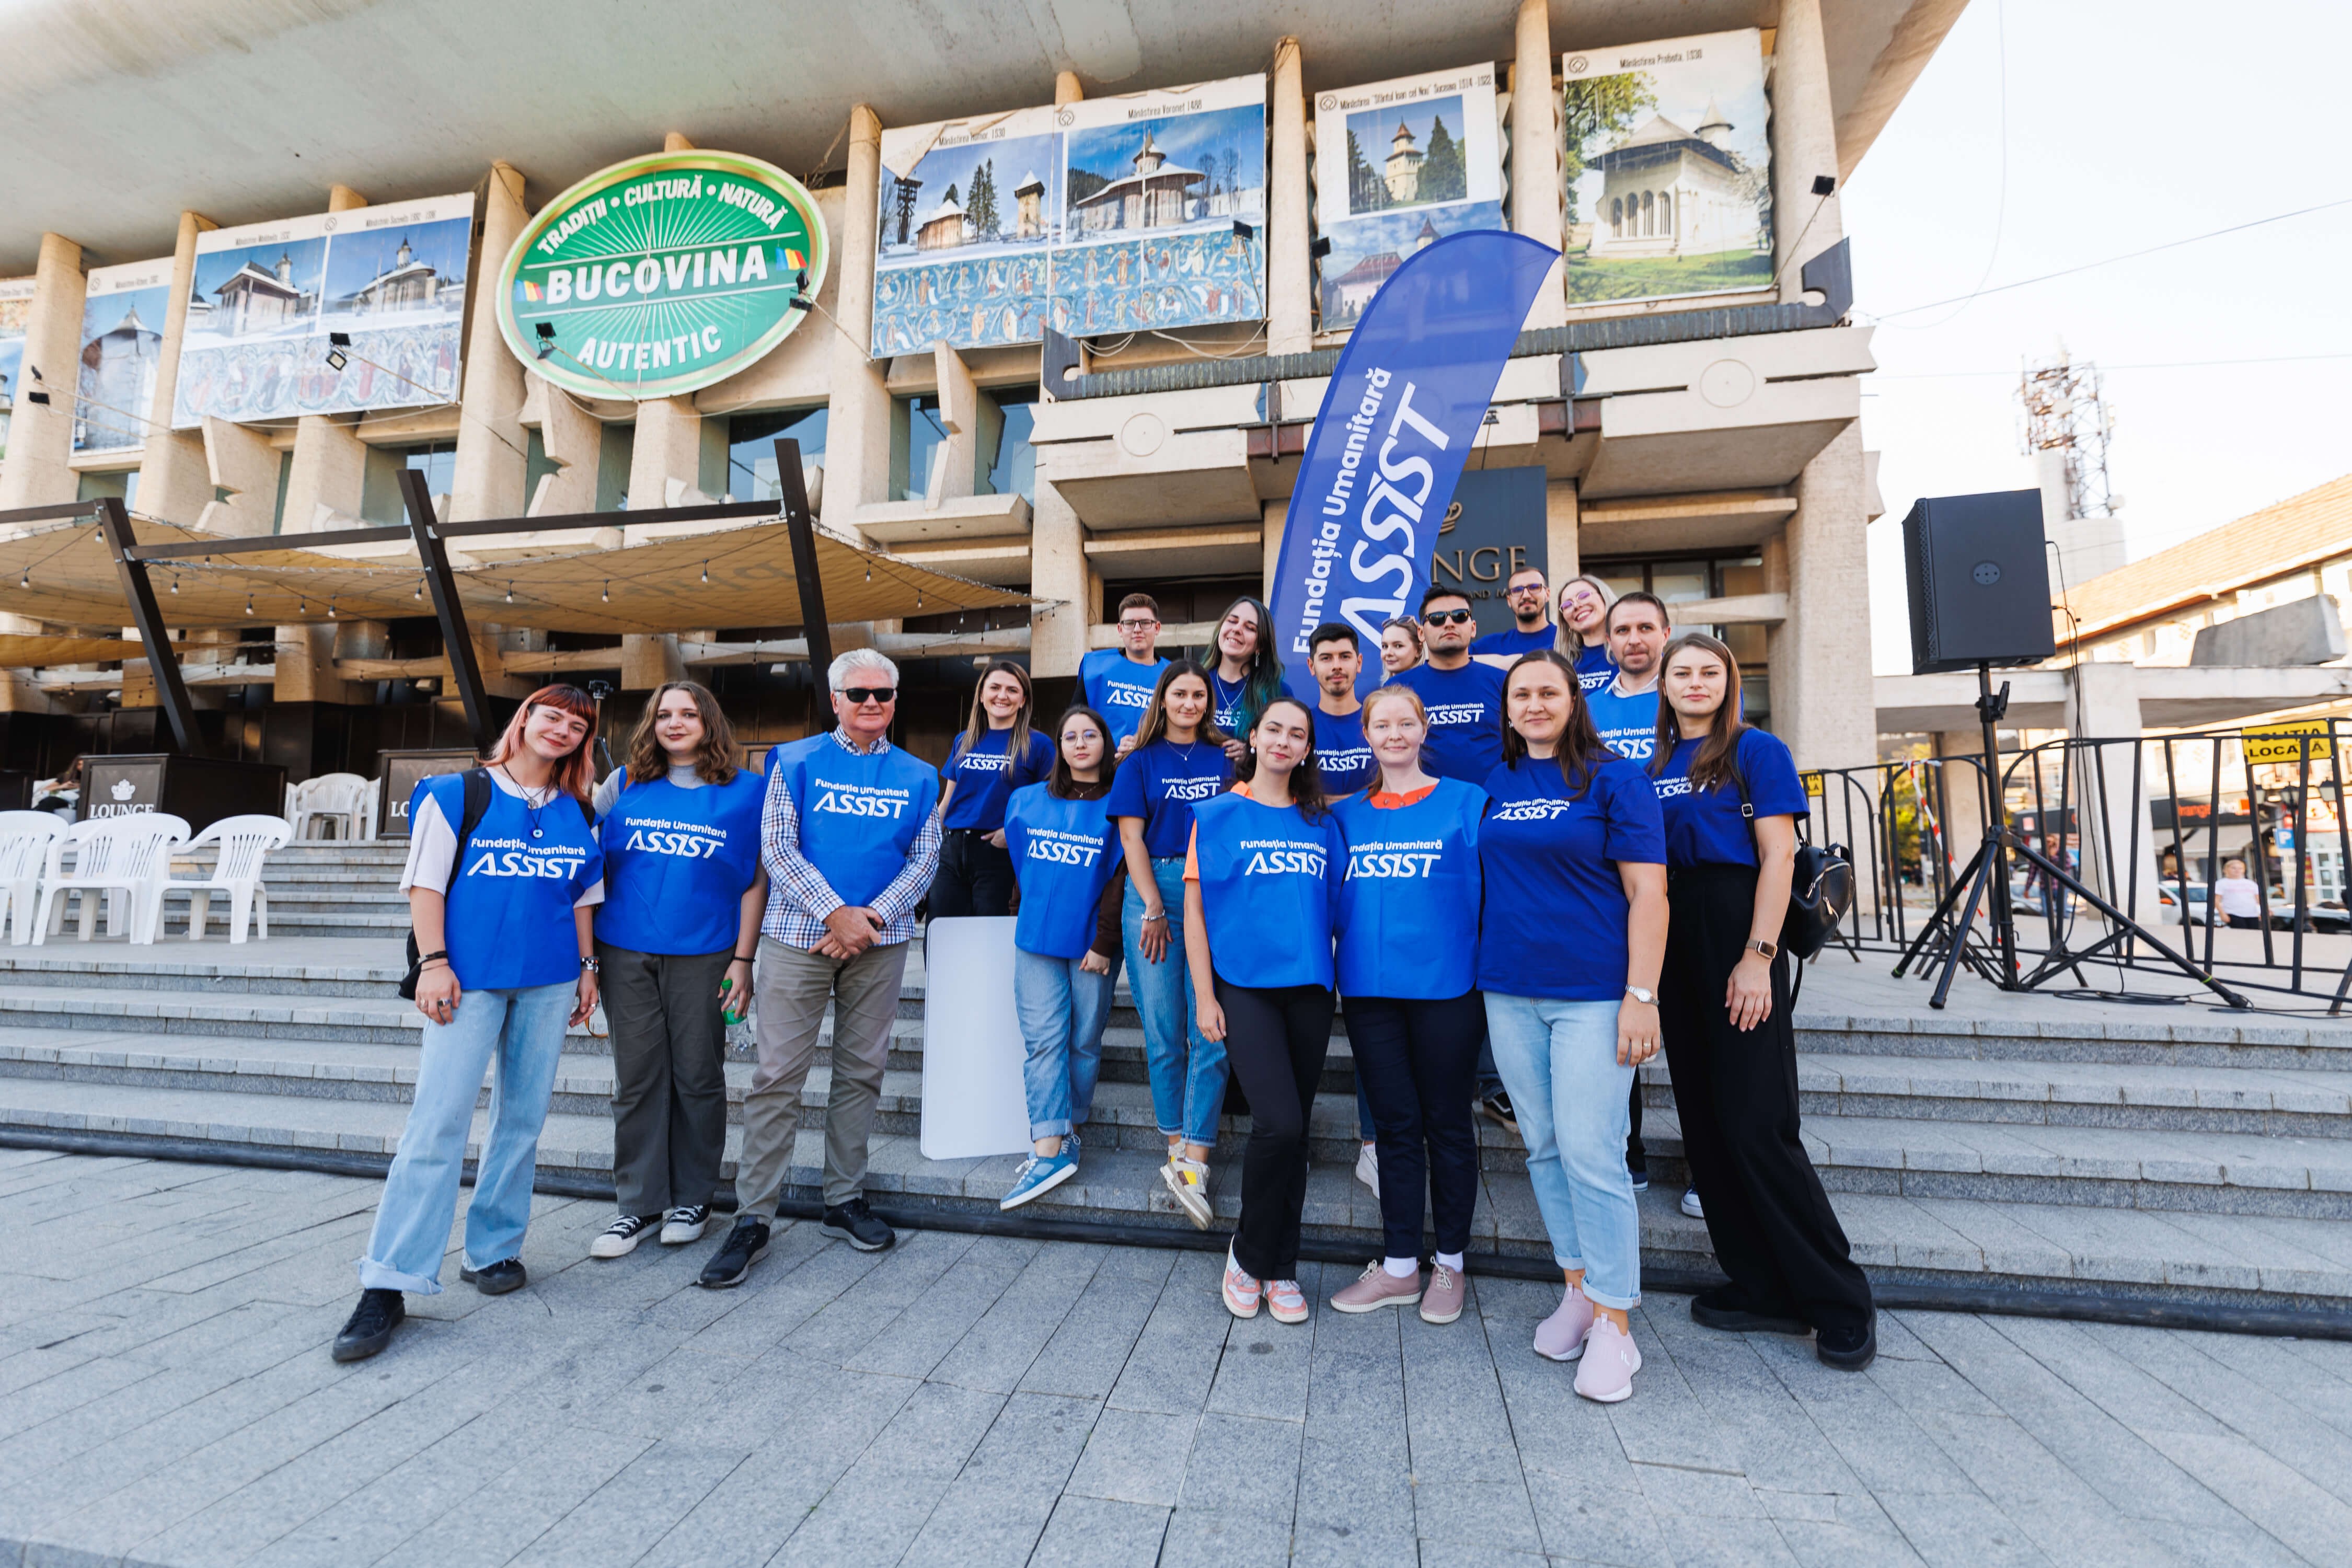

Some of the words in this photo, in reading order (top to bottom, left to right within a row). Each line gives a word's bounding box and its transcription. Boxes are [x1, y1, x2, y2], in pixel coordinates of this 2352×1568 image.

[624, 175, 702, 207] CULTURĂ
[718, 182, 789, 232] NATURĂ
[546, 245, 768, 305] BUCOVINA
[577, 325, 722, 370] AUTENTIC
[1323, 366, 1392, 516] Umanitară
[1339, 381, 1450, 651] ASSIST
[1432, 546, 1526, 584] NGE
[1106, 689, 1153, 709] ASSI
[1427, 709, 1484, 725] ASSIST
[1605, 738, 1656, 759] SSIS
[2249, 741, 2324, 757] LOCAĂ
[1317, 755, 1371, 771] ASSIST
[815, 778, 859, 793] Fundația
[860, 786, 909, 798] Umanitară
[1165, 782, 1221, 800] ASSIST
[813, 791, 909, 819] ASSIST
[1492, 804, 1568, 821] ASSIST
[625, 817, 671, 830] Fundația
[673, 821, 727, 839] Umanitară
[2278, 831, 2292, 845] P
[471, 838, 527, 851] Fundația
[625, 829, 724, 859] ASSIST
[1059, 832, 1104, 846] Umanitară
[1240, 839, 1287, 851] Fundația
[1385, 839, 1443, 850] Umanitară
[1027, 839, 1101, 868] ASSIST
[467, 852, 586, 880] ASSIST
[1244, 851, 1327, 881] ASSIST
[1345, 853, 1442, 882] ASSIST
